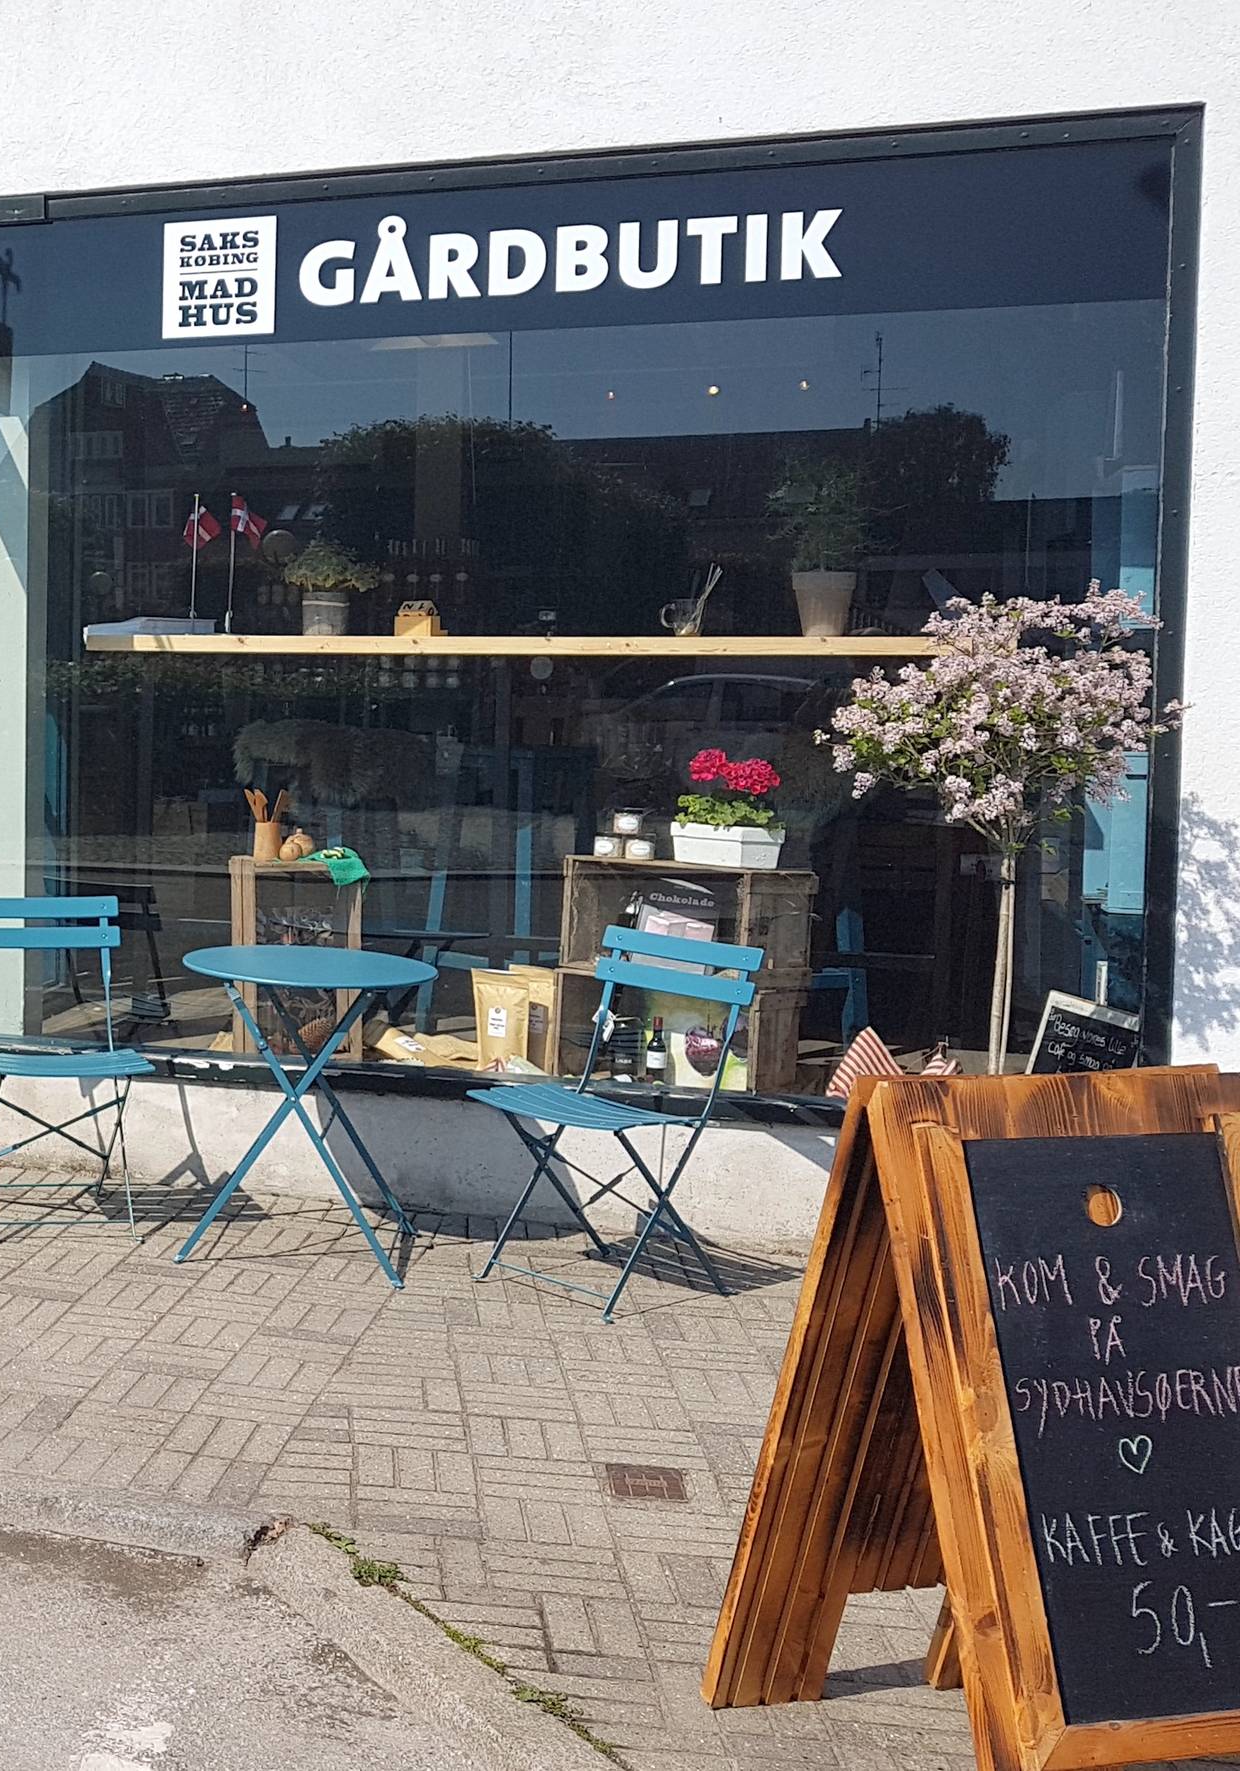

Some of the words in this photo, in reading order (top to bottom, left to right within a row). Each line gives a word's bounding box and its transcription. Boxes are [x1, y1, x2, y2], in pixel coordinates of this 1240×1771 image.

[179, 230, 259, 252] SAKS
[179, 252, 259, 268] KØBING
[298, 208, 843, 306] GÅRDBUTIK
[178, 277, 258, 301] MAD
[178, 301, 258, 327] HUS
[649, 893, 715, 907] Chokolade
[994, 1255, 1072, 1311] KOM
[1095, 1256, 1123, 1305] &
[1138, 1254, 1226, 1307] SMAG
[1089, 1315, 1126, 1365] PÅ
[1041, 1512, 1150, 1566] KAFFE
[1157, 1522, 1179, 1558] &
